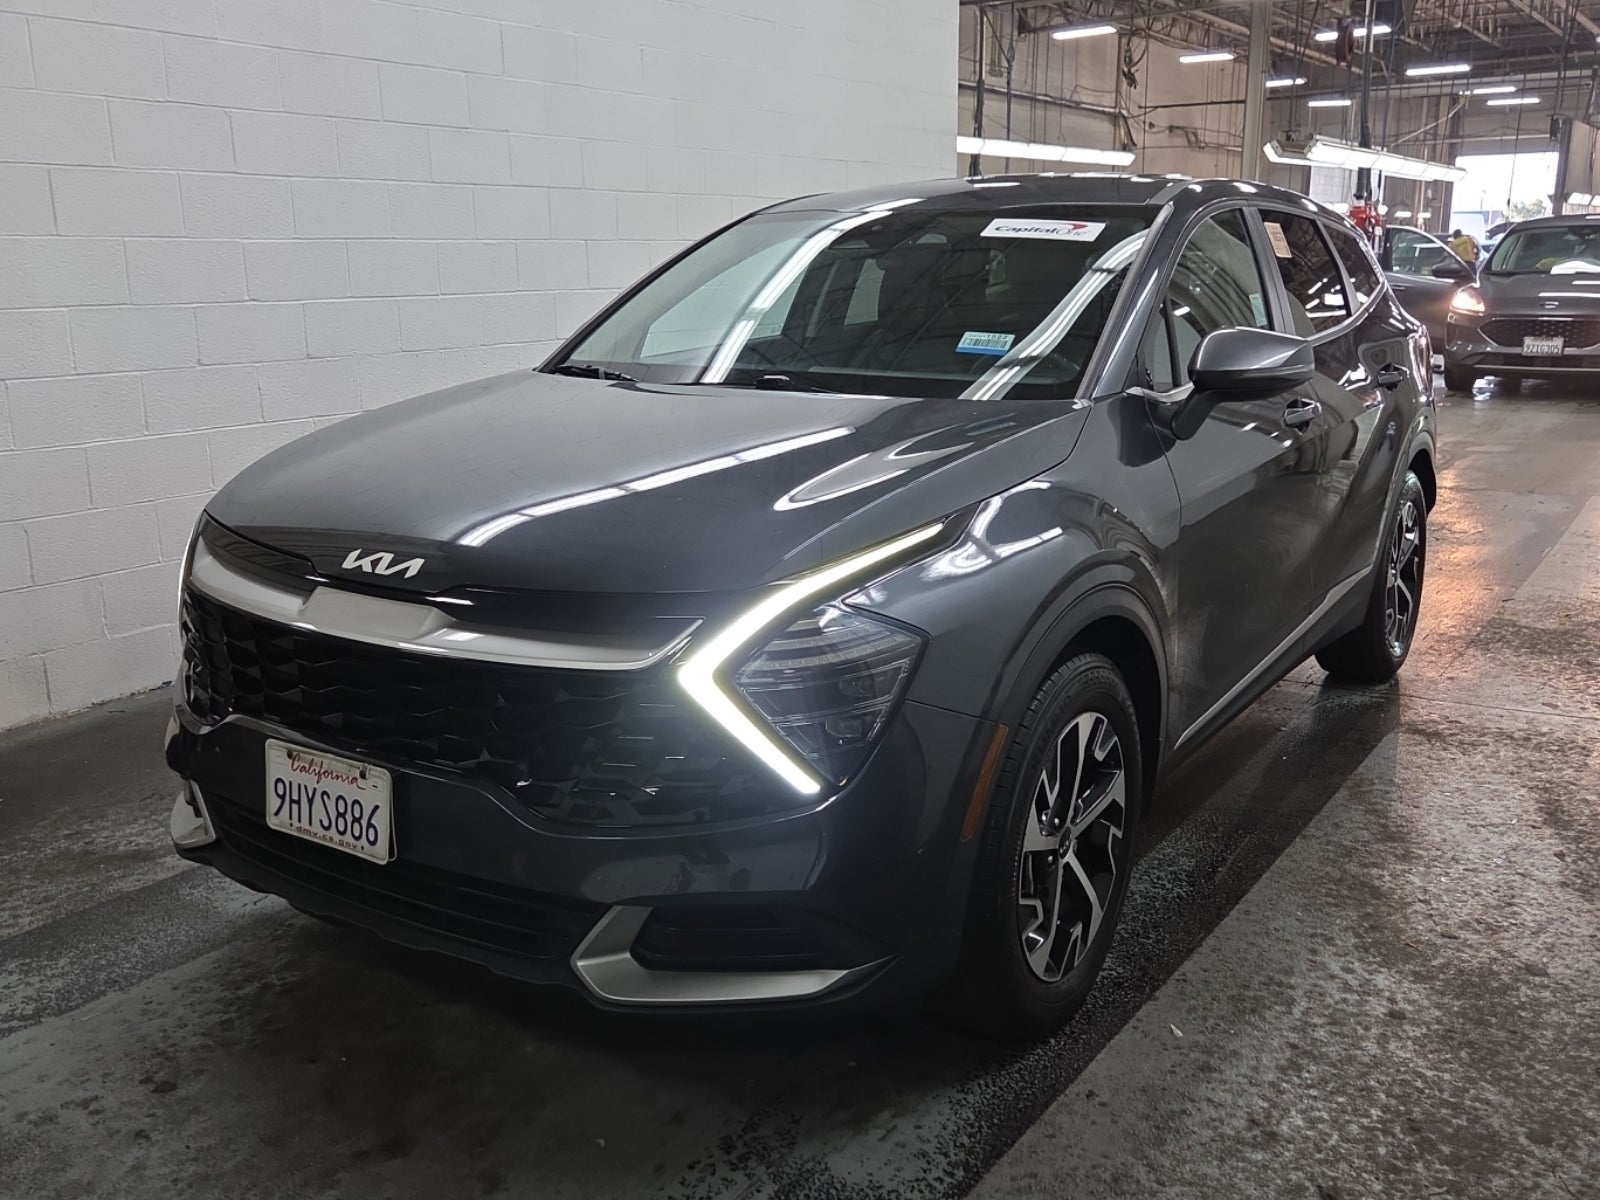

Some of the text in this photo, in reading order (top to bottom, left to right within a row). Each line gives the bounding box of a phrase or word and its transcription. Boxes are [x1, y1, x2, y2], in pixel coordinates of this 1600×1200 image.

[341, 548, 425, 579] KIA
[290, 752, 367, 790] California
[273, 777, 380, 847] 9HYS886
